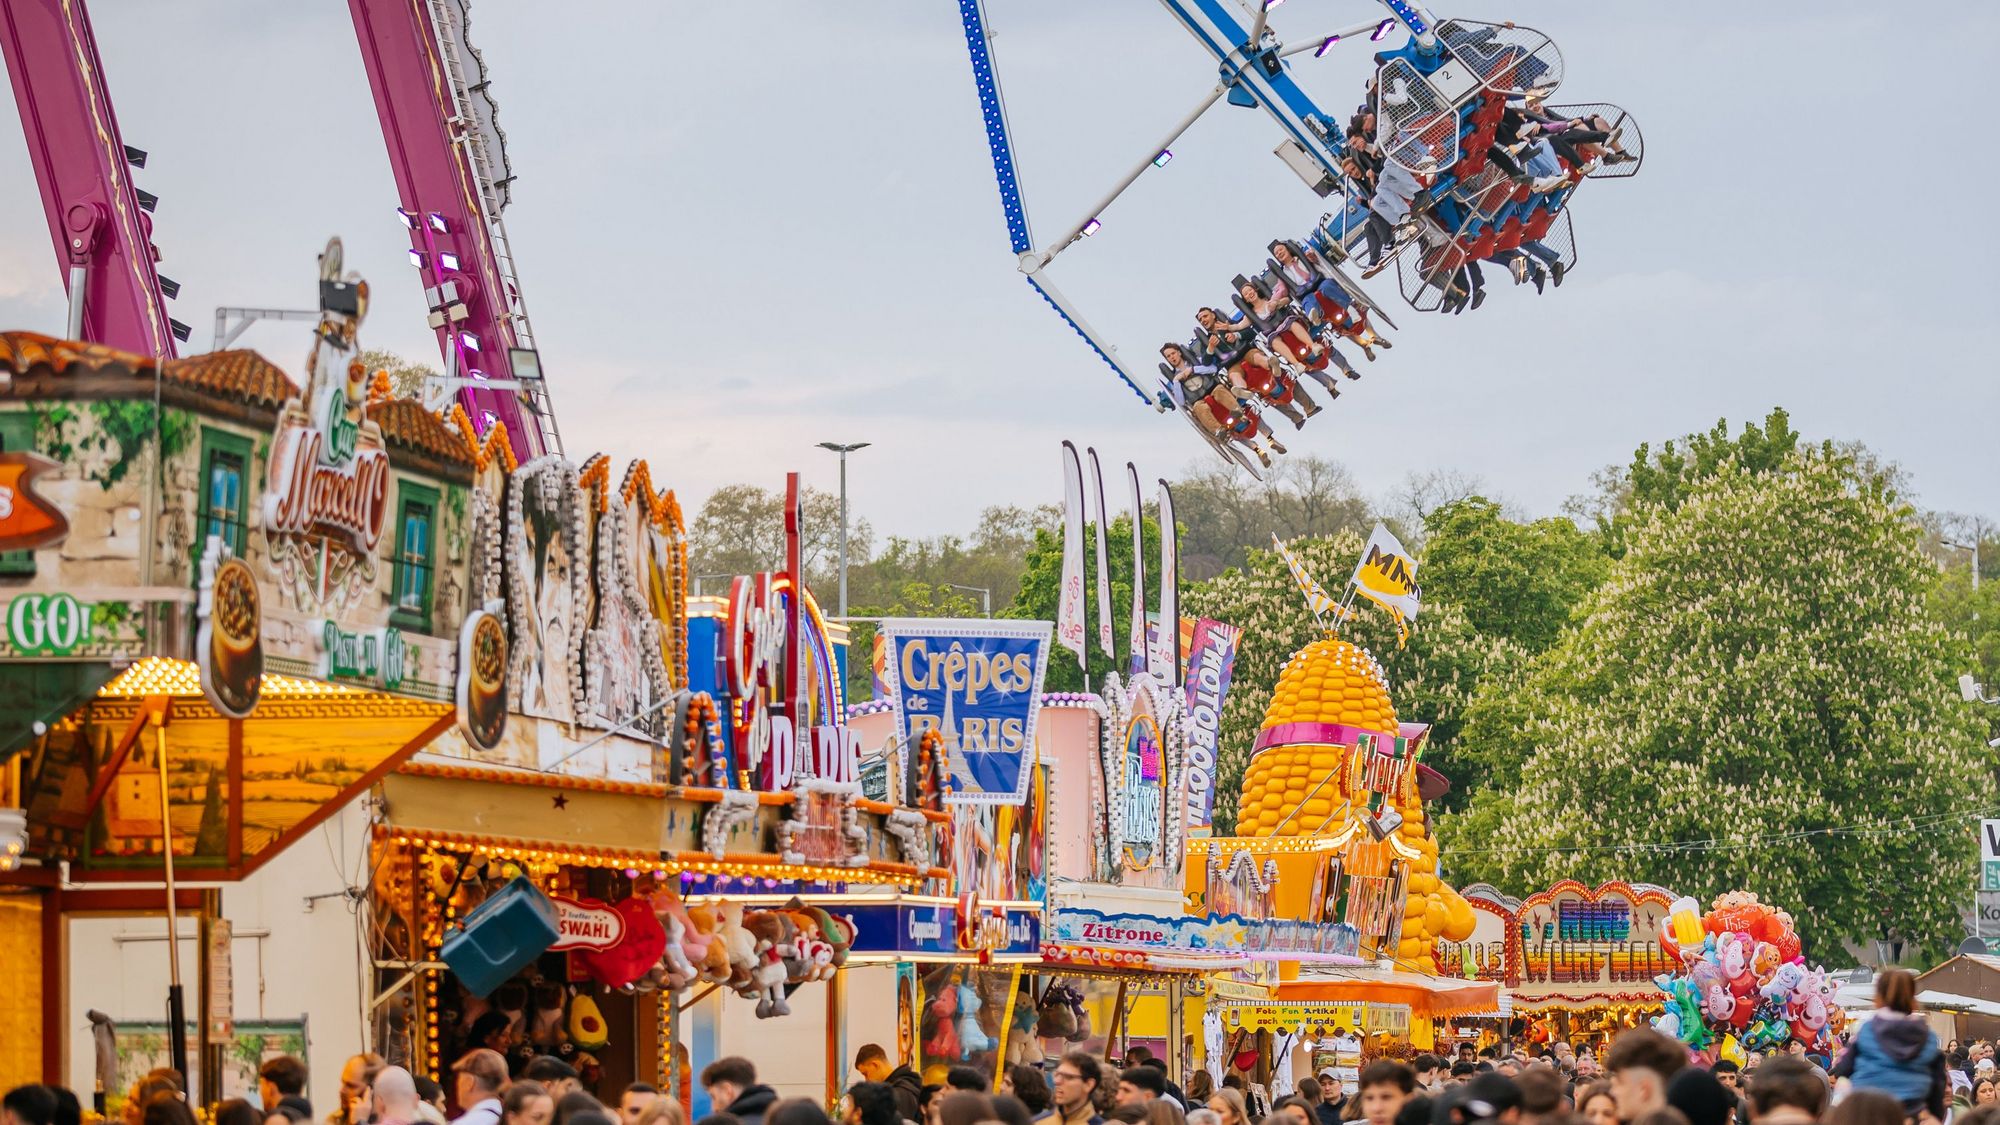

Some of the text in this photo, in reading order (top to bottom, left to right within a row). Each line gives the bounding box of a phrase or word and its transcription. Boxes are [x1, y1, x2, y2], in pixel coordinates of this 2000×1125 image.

[1442, 70, 1453, 81] 2
[11, 596, 92, 649] GO!
[902, 639, 1033, 705] Crêpes
[906, 694, 929, 711] de
[1083, 922, 1164, 942] Zitrone
[1256, 1007, 1338, 1015] Foto Fun Artikel
